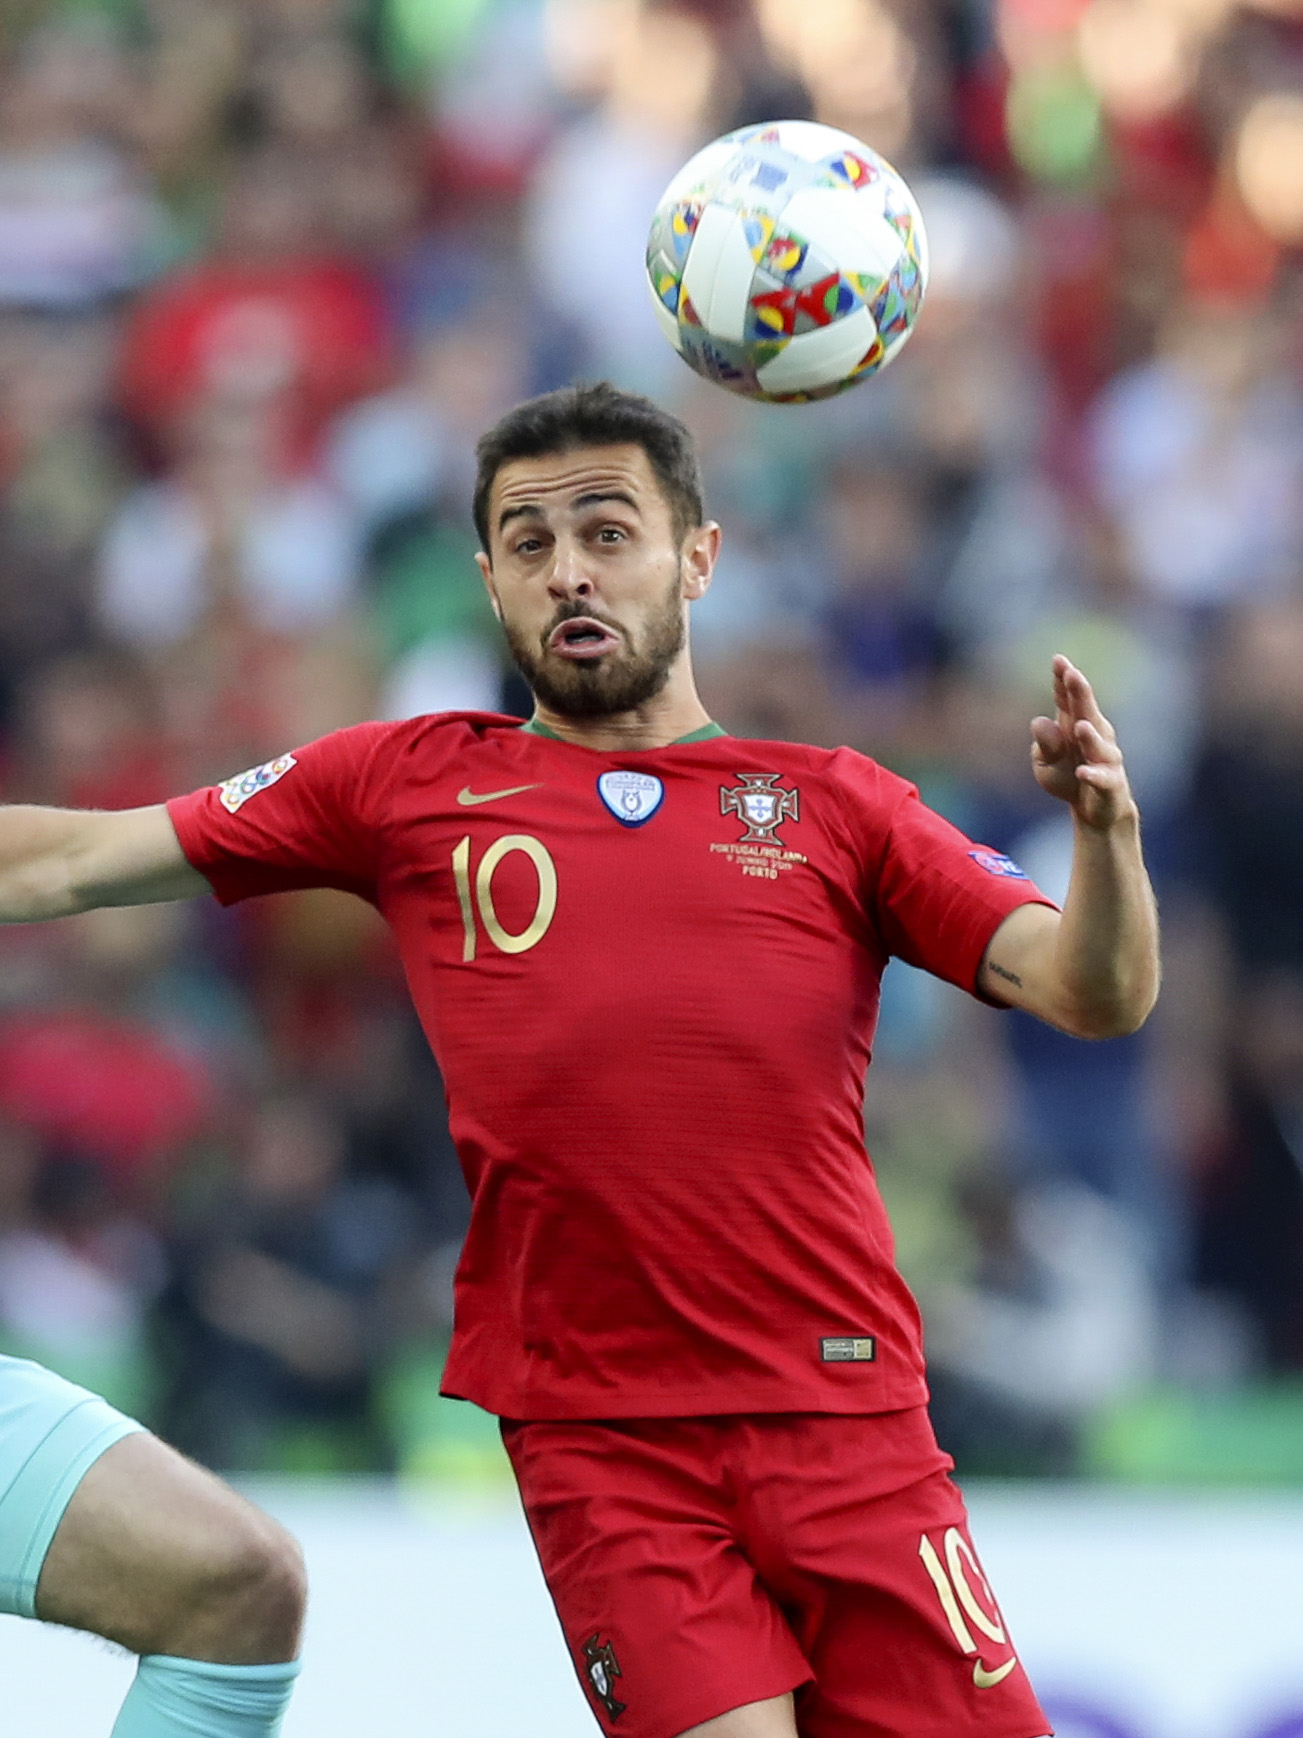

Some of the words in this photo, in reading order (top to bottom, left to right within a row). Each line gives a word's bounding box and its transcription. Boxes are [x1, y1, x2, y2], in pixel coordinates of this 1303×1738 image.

[452, 834, 558, 963] 10
[742, 865, 778, 880] PORTO
[918, 1527, 1006, 1654] 10
